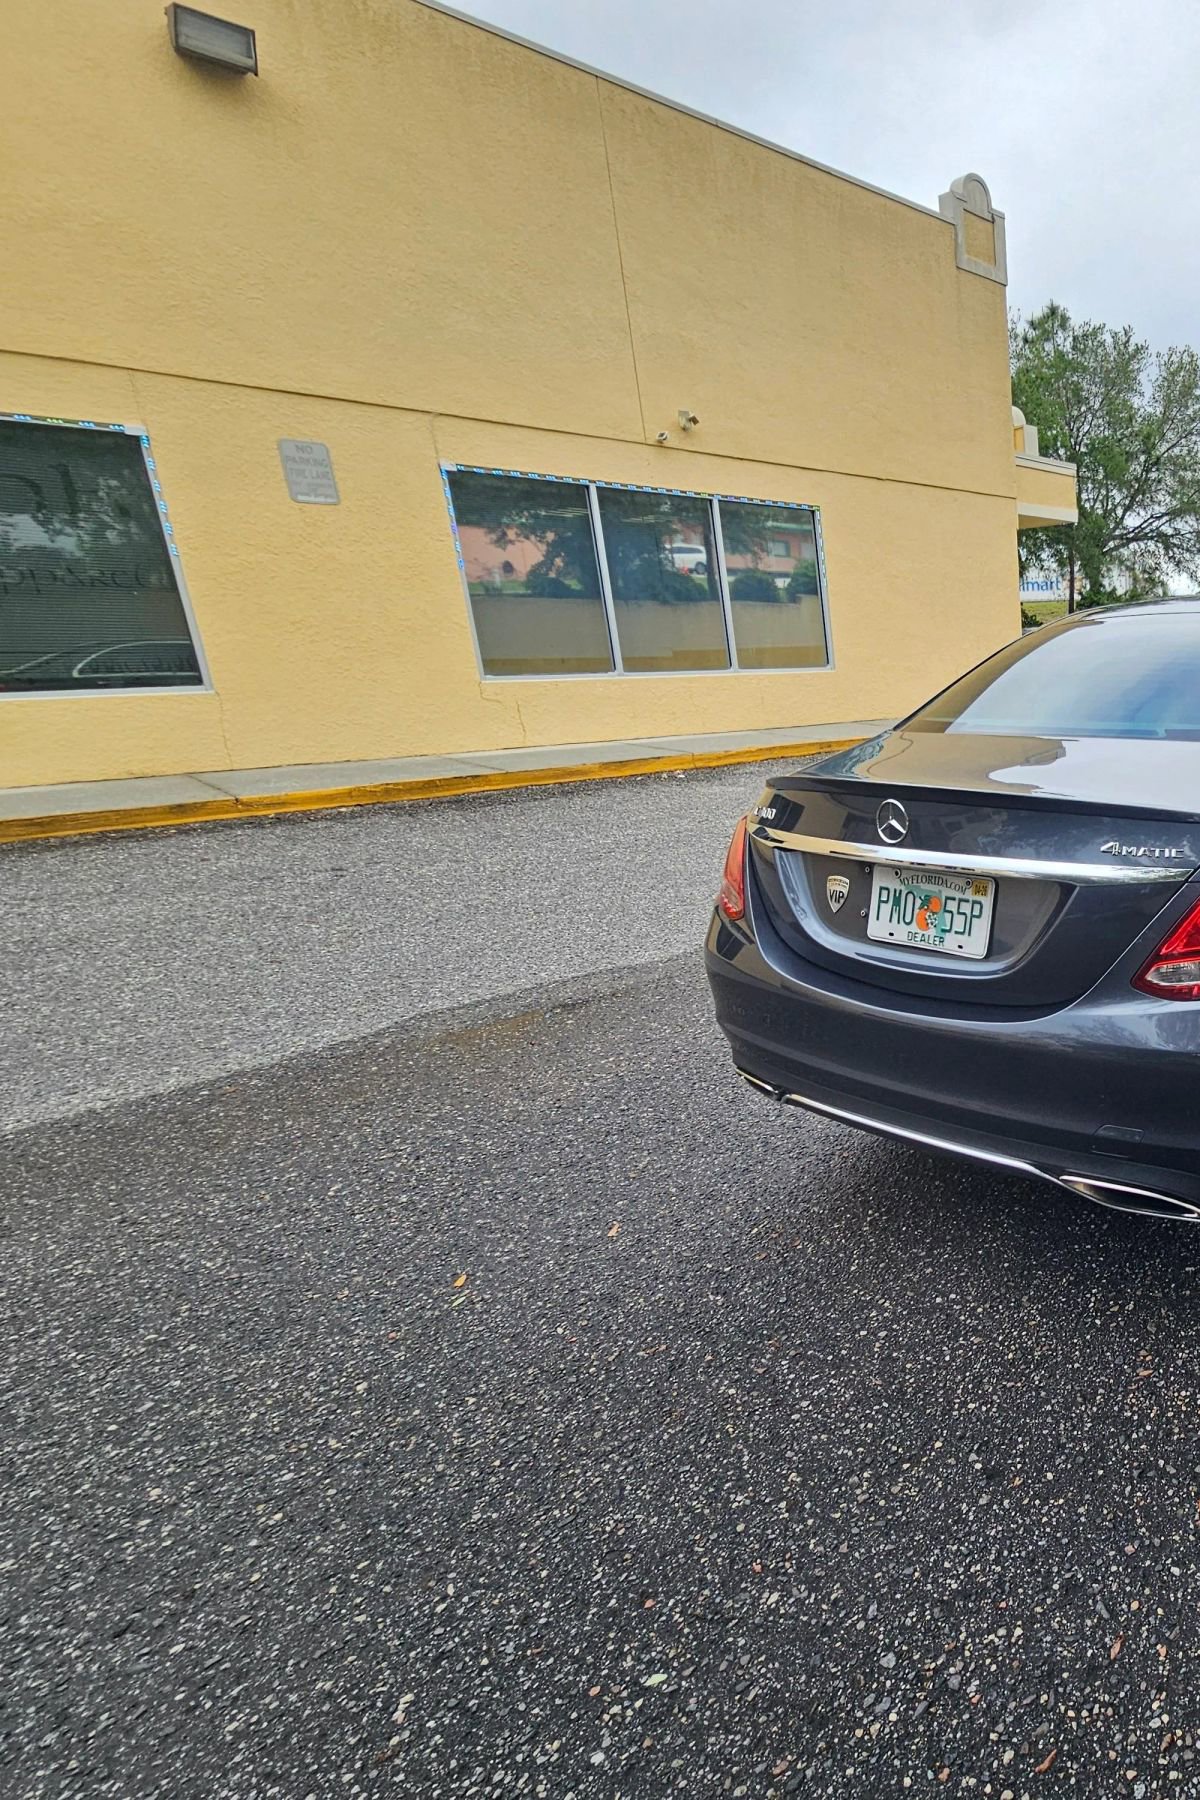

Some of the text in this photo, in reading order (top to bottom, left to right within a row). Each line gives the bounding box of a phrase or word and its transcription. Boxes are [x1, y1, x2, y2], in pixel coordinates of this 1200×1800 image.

[295, 444, 313, 454] NO
[1019, 577, 1061, 592] lmart
[1100, 841, 1185, 858] 4MATIC
[829, 888, 845, 904] VIP
[907, 931, 945, 947] DEALER
